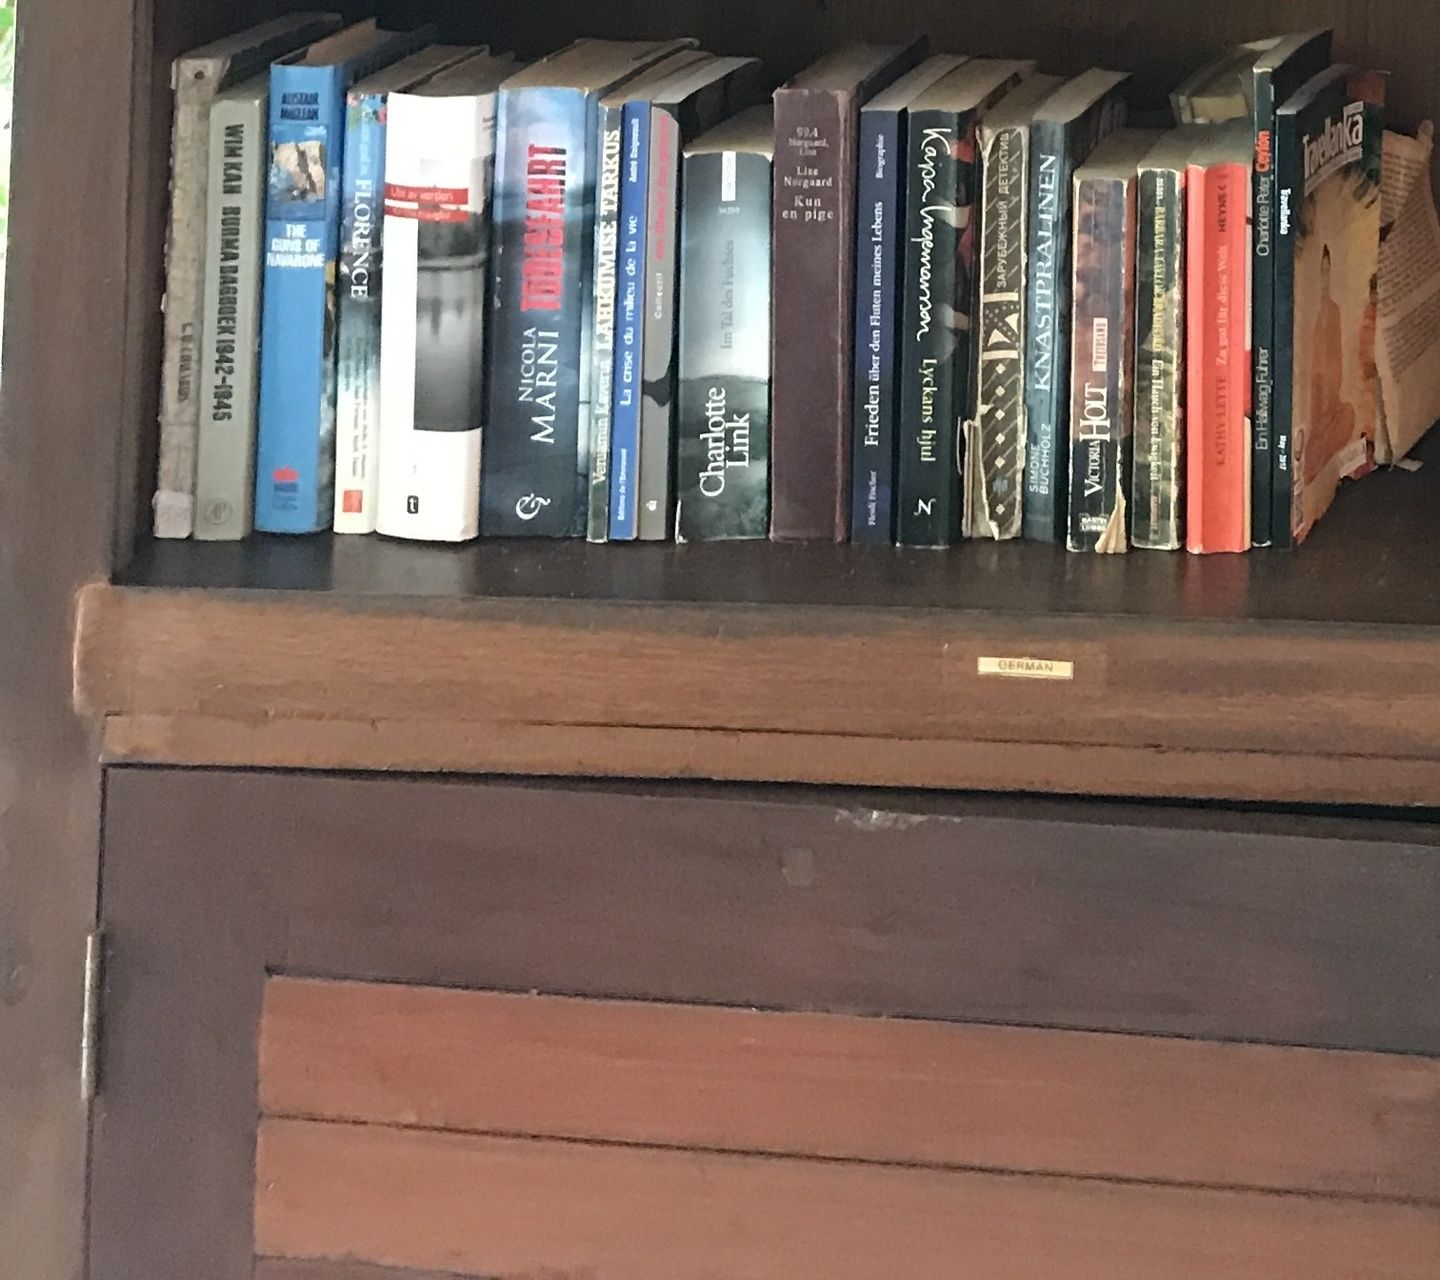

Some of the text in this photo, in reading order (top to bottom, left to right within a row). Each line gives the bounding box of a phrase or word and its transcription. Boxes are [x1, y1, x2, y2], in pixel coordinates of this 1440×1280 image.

[222, 123, 245, 162] WIM
[286, 223, 306, 238] THE
[350, 179, 372, 300] FLORENCE
[520, 142, 568, 312] TODESFAHRT
[782, 208, 834, 223] en pige
[794, 194, 822, 208] Kun
[595, 129, 621, 352] LAHKUMISE TARKUS
[1033, 152, 1057, 393] KNASTPRALINEN
[622, 326, 634, 345] du
[863, 201, 886, 446] Frieden über den Fluten meines Lebens
[211, 338, 237, 422] 1942-1945
[517, 325, 537, 402] NICOLA
[530, 328, 559, 444] MARNI
[620, 387, 633, 406] La
[699, 386, 729, 497] Charlotte
[725, 412, 752, 469] Link
[917, 358, 939, 463] Lyckans hjul
[1079, 381, 1112, 497] VICTORIA HOLT
[1029, 443, 1042, 494] SIMONE
[1039, 422, 1052, 495] BUCHHOLZ
[996, 661, 1054, 674] GERMAN
